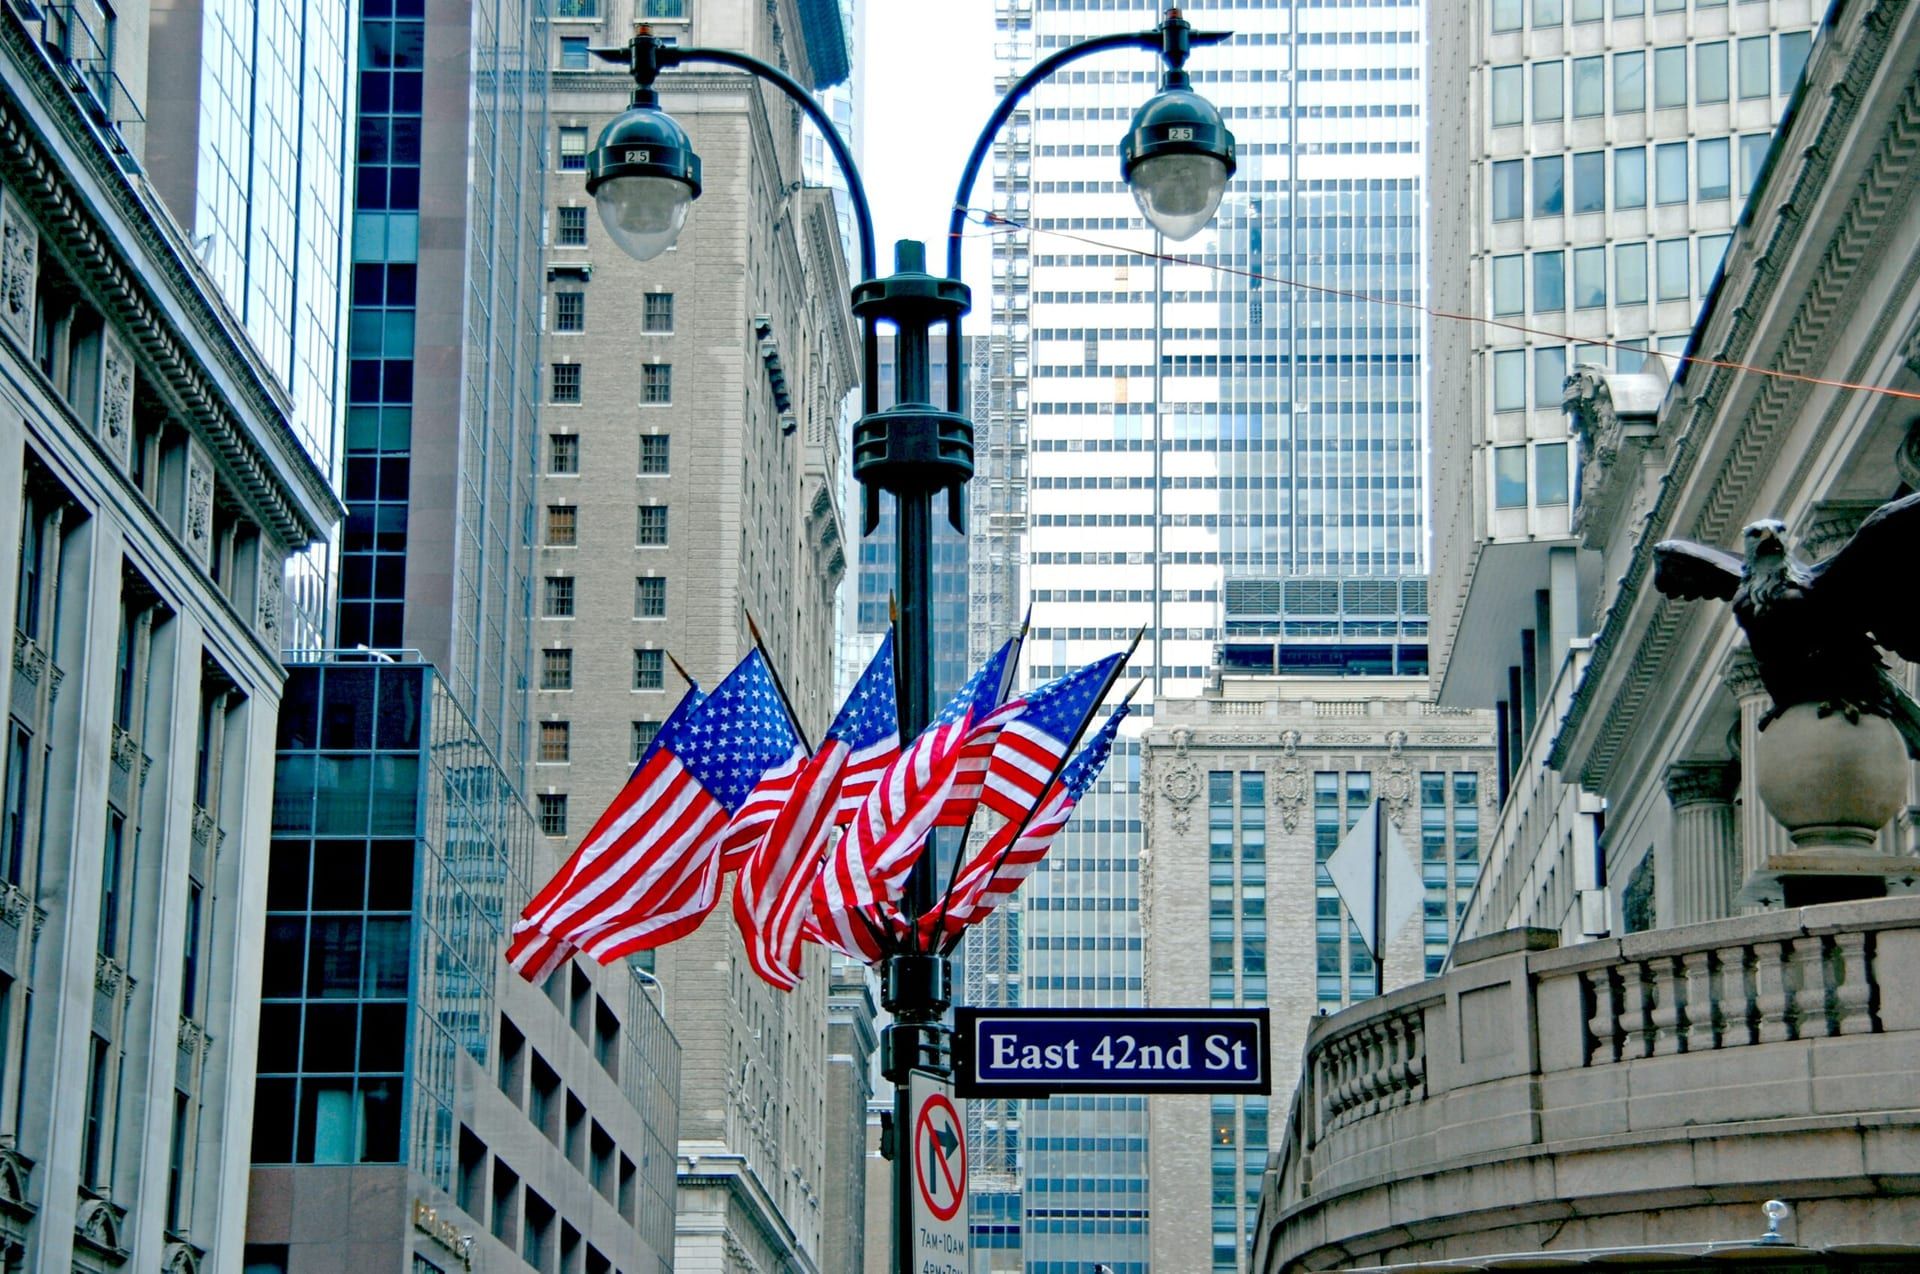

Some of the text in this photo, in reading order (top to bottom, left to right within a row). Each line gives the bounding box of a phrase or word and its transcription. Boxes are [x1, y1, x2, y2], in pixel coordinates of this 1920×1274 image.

[1171, 129, 1191, 140] 25
[627, 151, 648, 162] 25
[989, 1034, 1248, 1070] East 42nd St
[920, 1227, 965, 1257] 7AM-10AM
